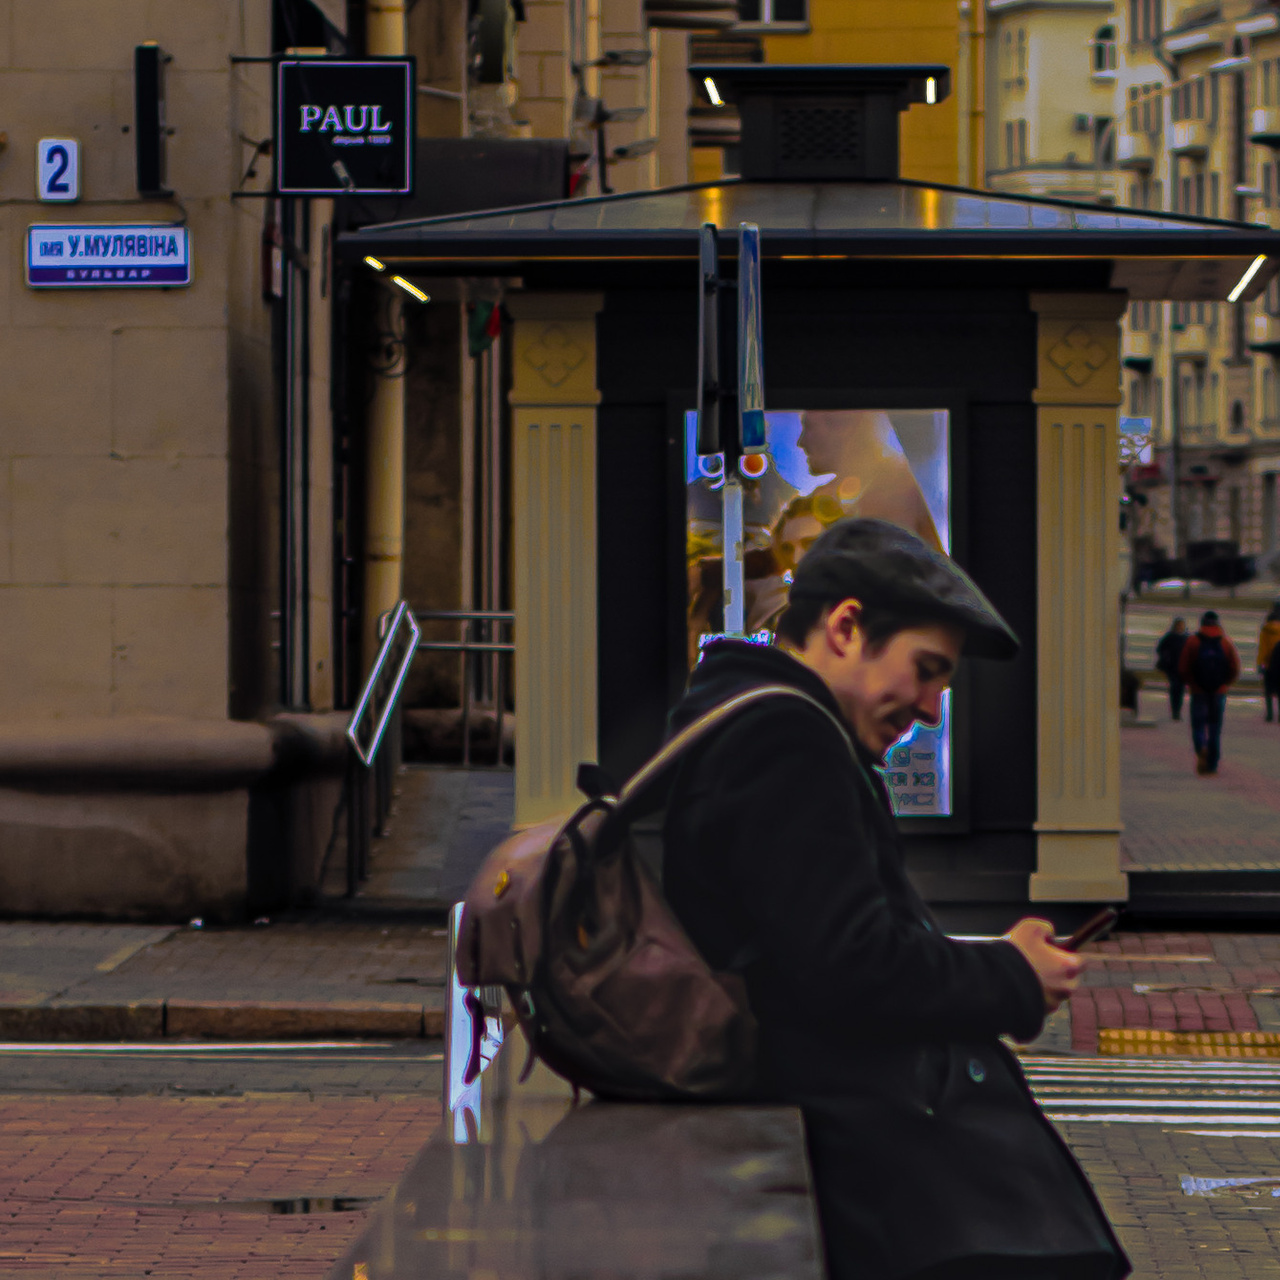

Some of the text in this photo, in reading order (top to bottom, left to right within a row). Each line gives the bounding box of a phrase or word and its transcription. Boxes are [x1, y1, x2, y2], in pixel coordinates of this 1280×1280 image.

[299, 105, 392, 133] PAUL
[46, 144, 69, 193] 2
[67, 234, 178, 257] У.МУЛЯВІНА
[66, 269, 151, 280] БУЛЬВАР
